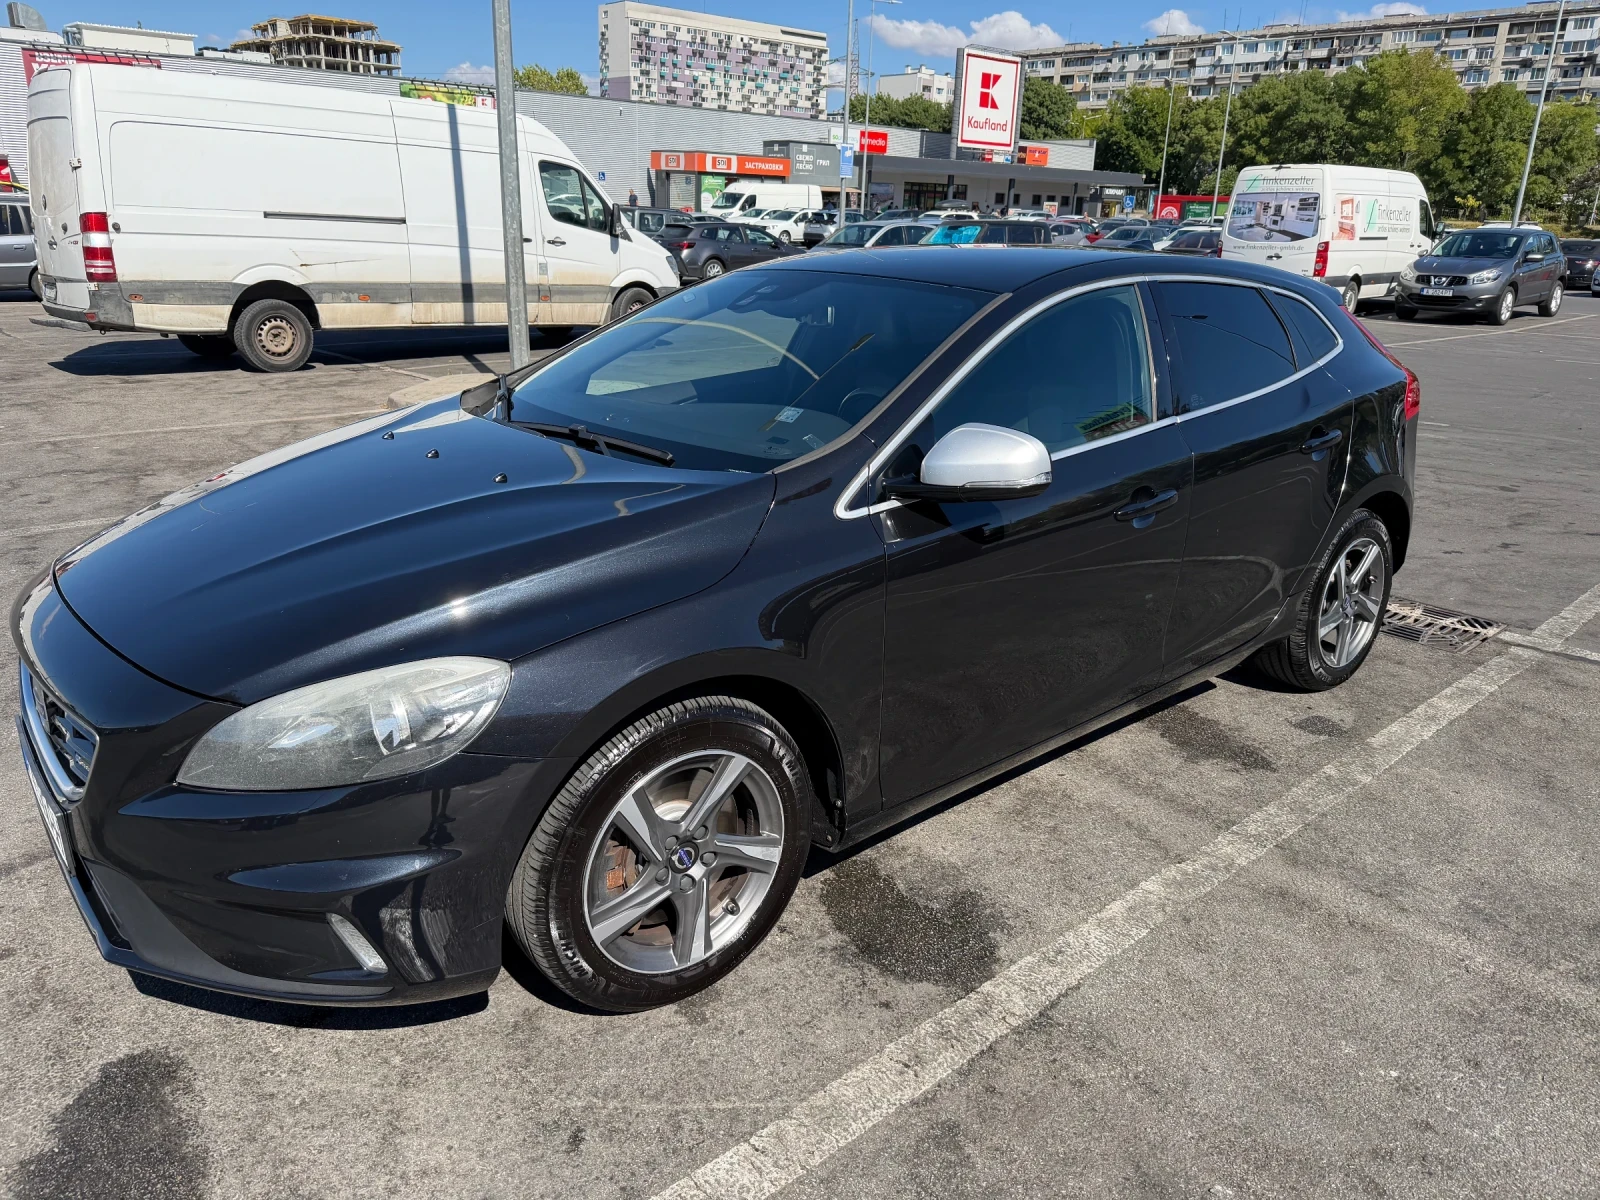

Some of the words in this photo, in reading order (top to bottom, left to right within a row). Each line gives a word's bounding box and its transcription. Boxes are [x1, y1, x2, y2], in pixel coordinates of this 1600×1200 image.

[967, 115, 1008, 132] Kaufland
[716, 159, 727, 167] SDI
[744, 161, 783, 171] ЗАСТРАХОВКИ
[816, 159, 830, 167] ГРИЛ
[1262, 175, 1316, 185] finkenzeller
[1378, 203, 1412, 222] finkenzeller
